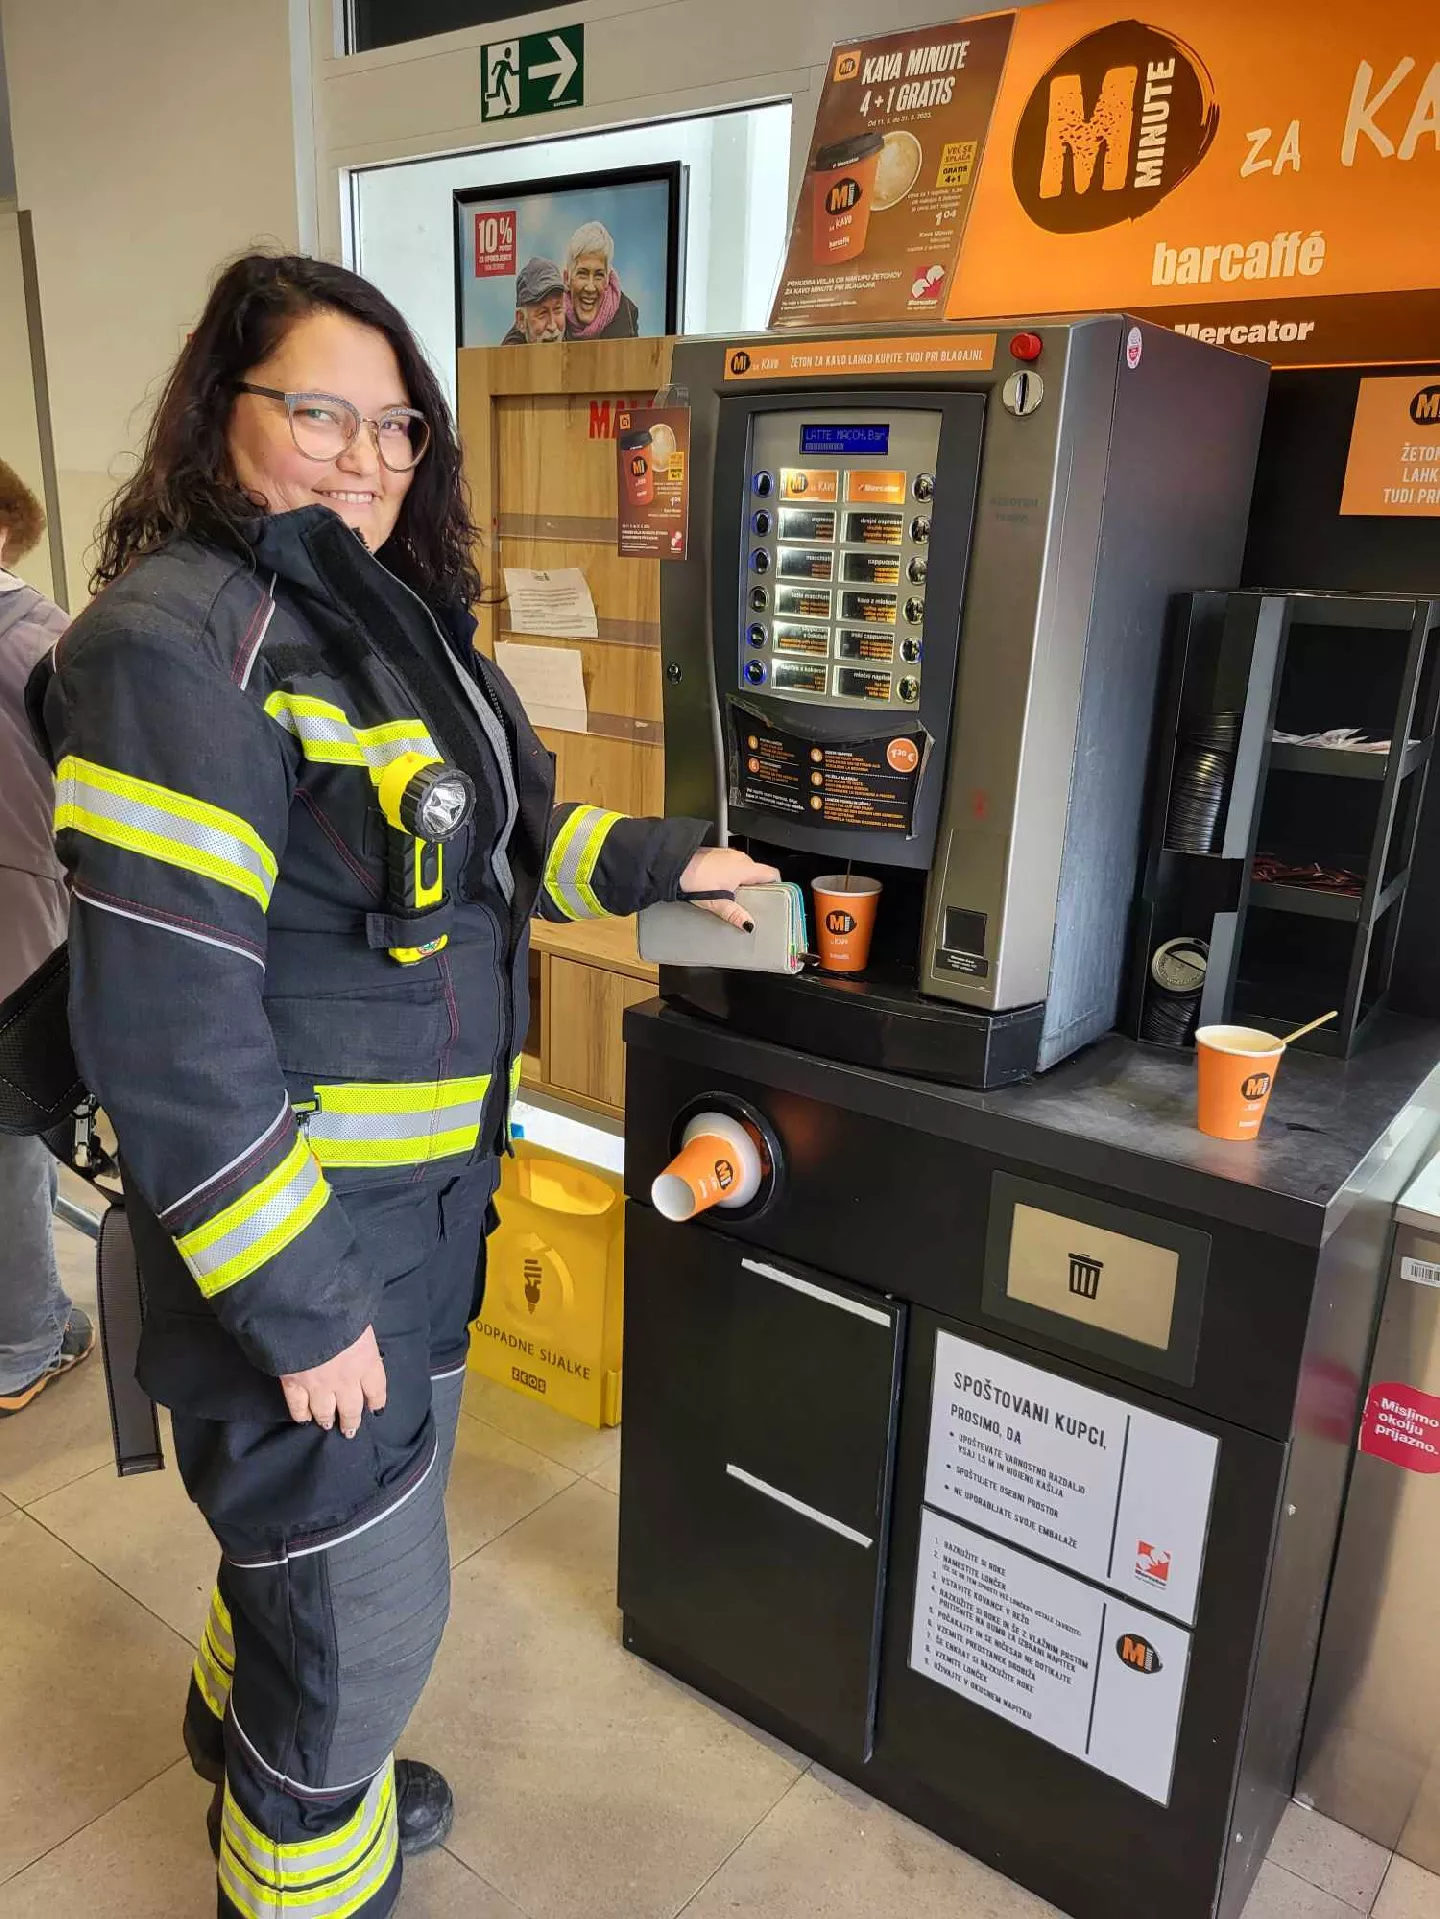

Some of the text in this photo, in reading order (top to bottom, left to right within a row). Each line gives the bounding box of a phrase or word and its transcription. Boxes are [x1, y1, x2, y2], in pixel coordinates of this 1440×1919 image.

[905, 40, 970, 77] MINUTE
[860, 76, 956, 117] 4 + 1 GRATIS
[1039, 66, 1139, 199] M
[1134, 57, 1175, 189] MINUTE
[1239, 119, 1300, 179] ZA
[943, 164, 968, 175] GRATIS
[944, 175, 962, 184] 4+1
[478, 216, 513, 254] 10%
[1151, 230, 1326, 286] barcaffé
[793, 286, 811, 295] KAVO
[811, 284, 835, 293] MINUTE
[816, 277, 835, 286] VELJA
[845, 273, 872, 283] NAKUPU
[1174, 319, 1315, 345] Mercator
[790, 354, 813, 369] ŽETON
[814, 355, 824, 367] ZA
[825, 354, 847, 366] KAVO
[847, 353, 873, 366] LAHKO
[874, 352, 903, 364] KUPITE
[904, 351, 923, 363] TUDI
[924, 350, 939, 362] PRI
[805, 428, 833, 441] LATTE
[1383, 488, 1413, 503] TUDI
[475, 1319, 591, 1381] ODPADNE SIJALKE
[950, 1403, 1022, 1445] PROSIMO, DA
[953, 1371, 1107, 1450] SPOŠTOVANI KUPCI,
[1378, 1411, 1424, 1437] okolju
[1381, 1397, 1440, 1429] Mislimo
[1375, 1423, 1440, 1456] prijazno.
[958, 1433, 1086, 1495] UPOŠTEVATE VARNOSTNO RAZDALJO
[958, 1444, 975, 1459] VSAJ
[988, 1458, 995, 1468] M
[996, 1462, 1005, 1473] IN
[1006, 1466, 1034, 1485] HIGIENO
[1035, 1477, 1064, 1498] KAŠLJA
[956, 1465, 1059, 1518] SPOŠTUJETE OSEBNI PROSTOR
[953, 1486, 1078, 1549] NE UPORABLJATE SVOJE EMBALAŽE
[943, 1554, 980, 1579] NAMESTITE
[981, 1572, 1006, 1591] LONČEK
[944, 1540, 979, 1564] RAZKUŽITE
[988, 1562, 1006, 1577] ROKE
[941, 1575, 972, 1597] VSTAVITE
[973, 1591, 1004, 1612] KOVANCE
[936, 1623, 963, 1643] VZEMITE
[937, 1610, 974, 1635] POČAKAJTE
[994, 1639, 1023, 1660] NIČESAR
[1023, 1655, 1034, 1665] NE
[939, 1587, 975, 1611] RAZKUŽITE
[983, 1610, 1001, 1626] ROKE
[1002, 1620, 1010, 1630] IN
[1028, 1633, 1059, 1655] VLAŽNIM
[1060, 1648, 1089, 1670] PRSTOM
[939, 1597, 974, 1621] PRITISNITE
[975, 1614, 985, 1626] NA
[1017, 1637, 1045, 1658] IZBRANI
[1046, 1651, 1076, 1673] NAPITEK
[935, 1650, 962, 1669] VZEMITE
[962, 1664, 988, 1683] LONČEK
[945, 1641, 970, 1660] ENKRAT
[980, 1658, 1015, 1684] RAZKUŽITE
[962, 1677, 969, 1686] V
[969, 1680, 1002, 1705] OKUSNEM
[1002, 1698, 1033, 1720] NAPITKU
